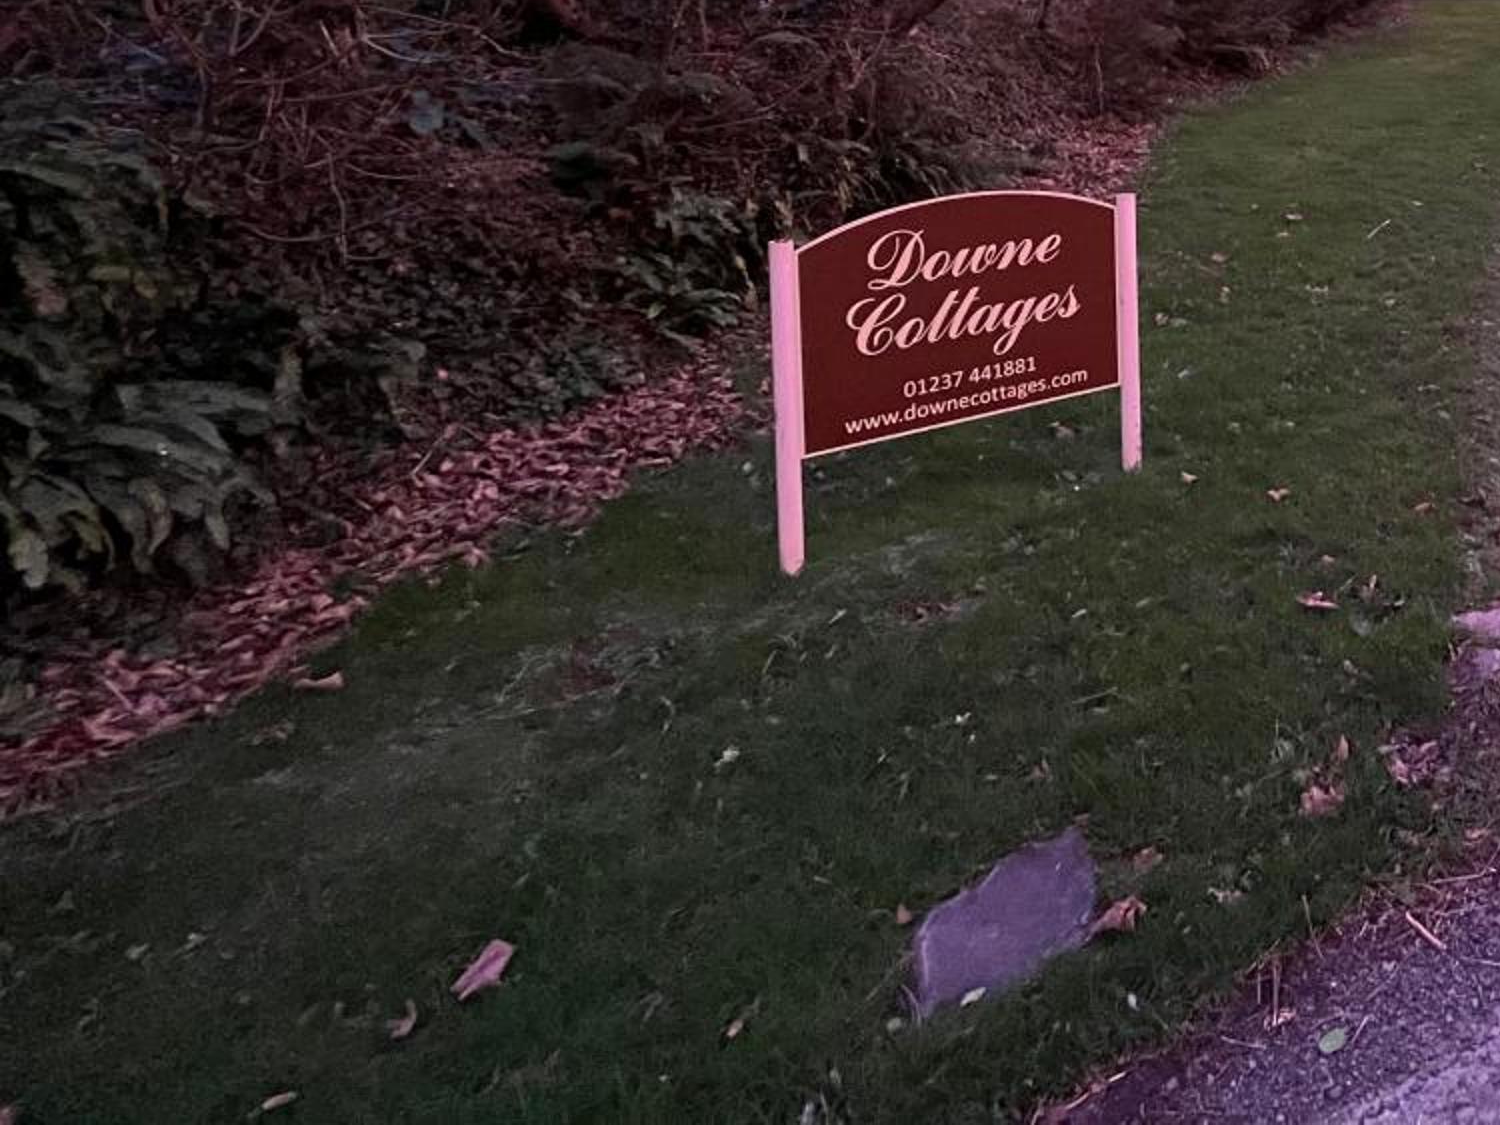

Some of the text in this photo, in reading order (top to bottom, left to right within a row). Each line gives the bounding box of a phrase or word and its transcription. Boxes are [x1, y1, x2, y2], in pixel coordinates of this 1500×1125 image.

[867, 229, 1062, 290] Downe
[846, 284, 1081, 356] Cottages
[845, 369, 1088, 434] www.downecottages.com
[903, 356, 1037, 398] 01237 441881
